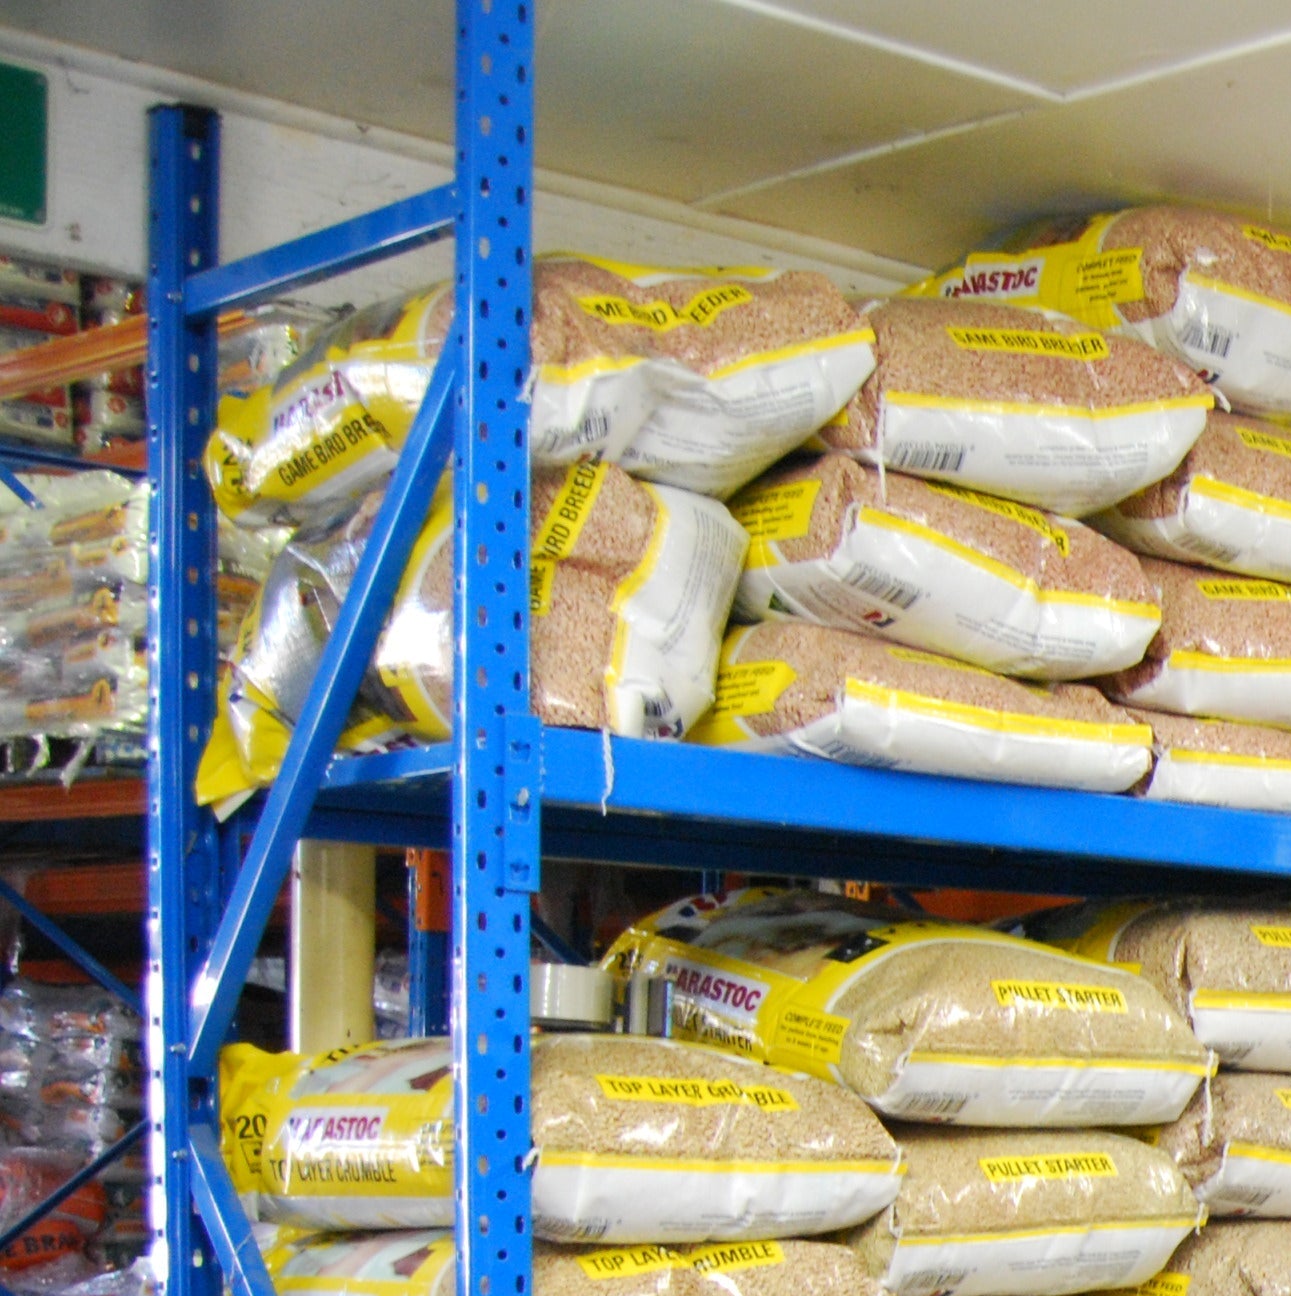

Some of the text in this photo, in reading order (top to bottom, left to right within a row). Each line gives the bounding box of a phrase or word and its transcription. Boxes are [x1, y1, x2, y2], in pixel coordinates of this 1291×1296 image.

[1004, 332, 1039, 350] BIRD
[278, 434, 347, 487] GAME BIRD
[998, 984, 1122, 1007] PULLET STARTER
[606, 1080, 644, 1095] TOP
[649, 1083, 703, 1100] LAYER
[987, 1157, 1112, 1178] PULLET STARTER
[589, 1254, 625, 1274] TOP
